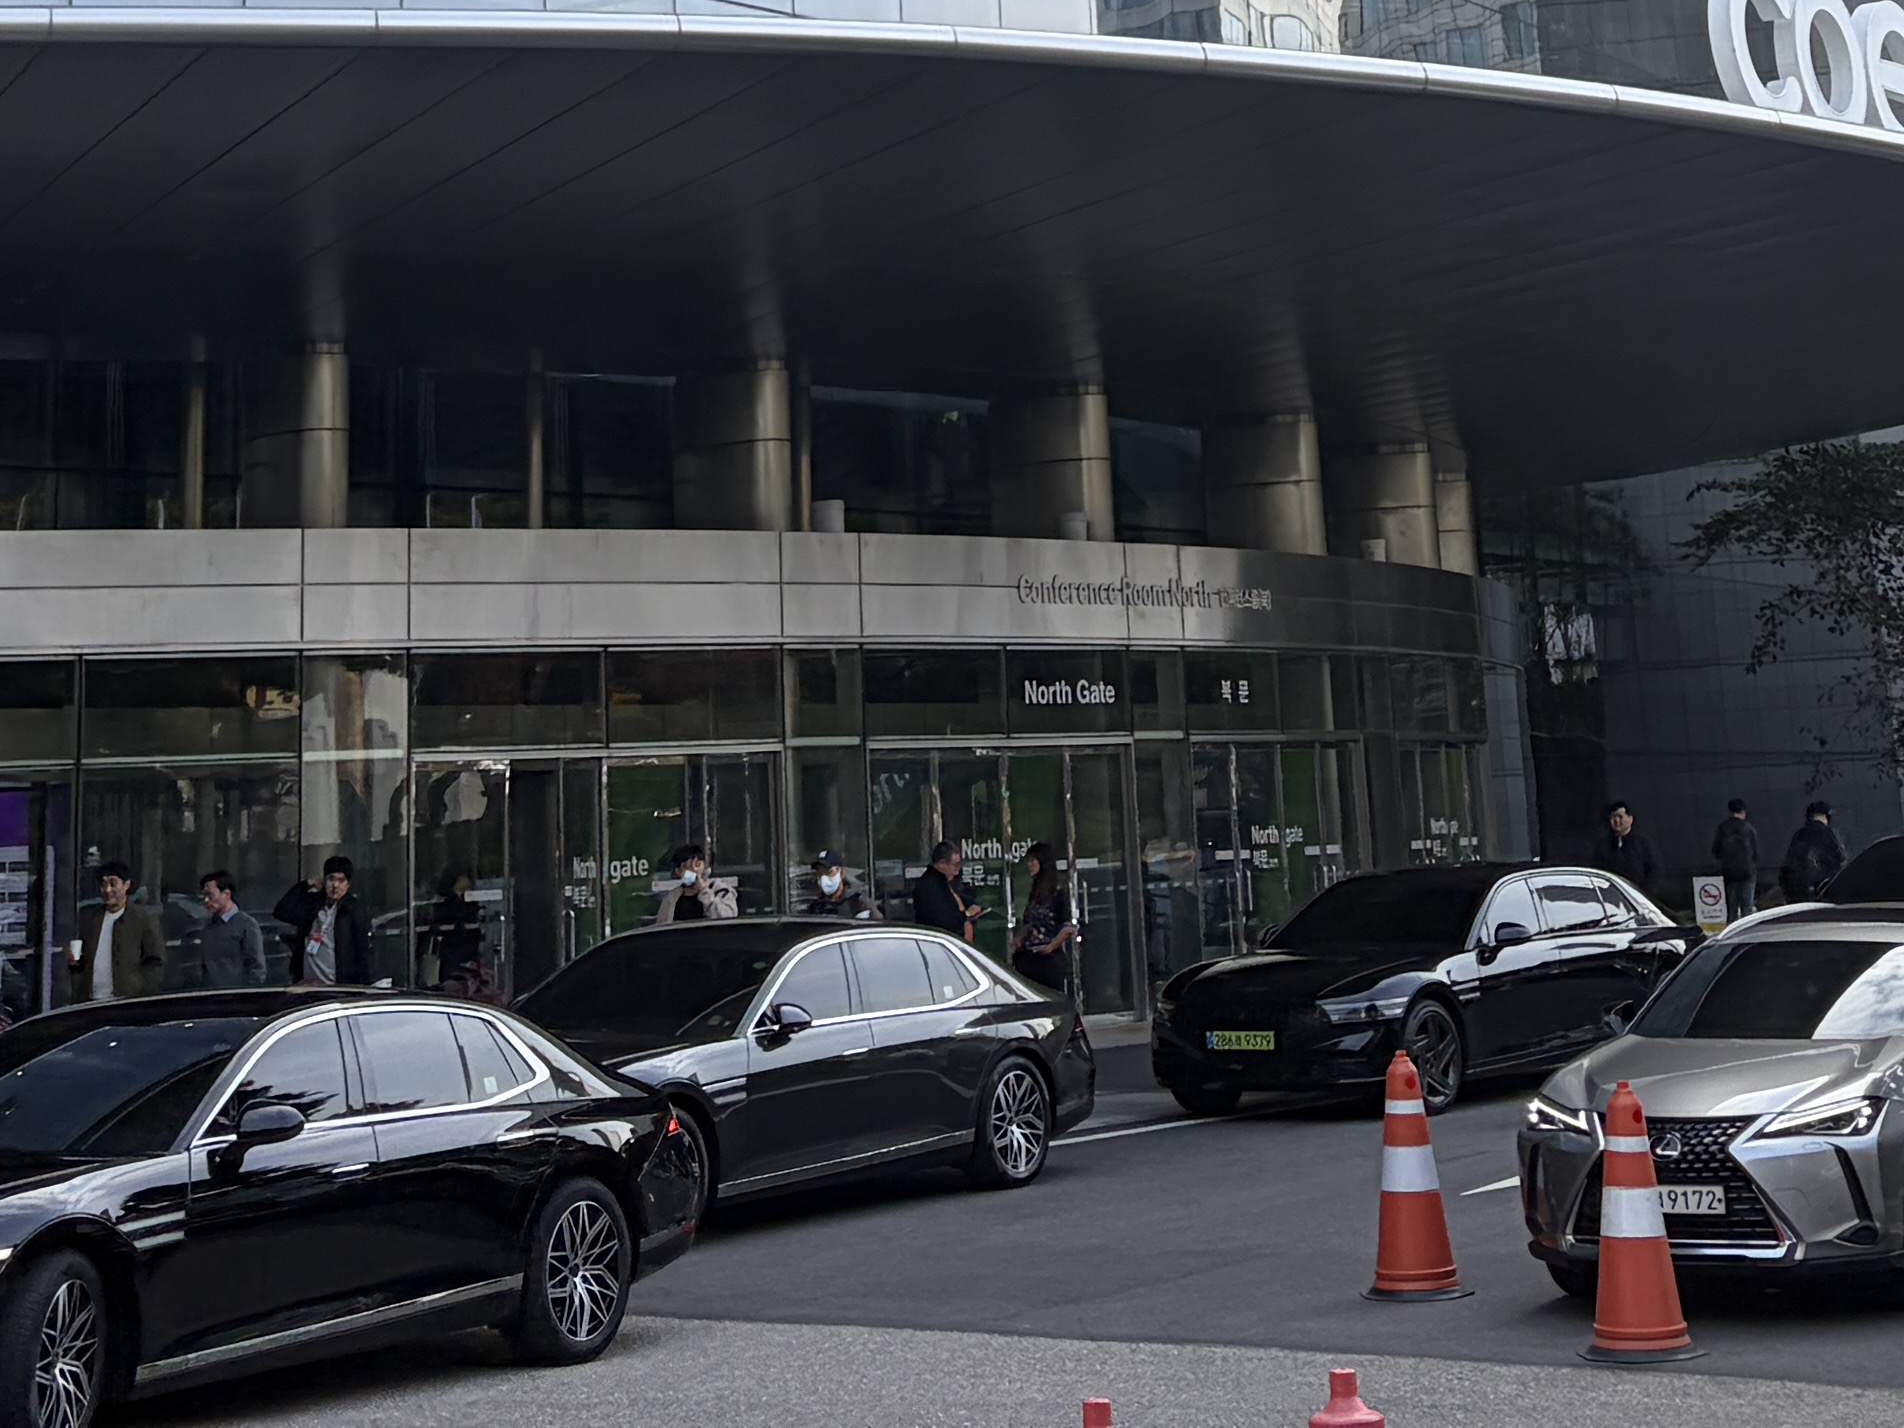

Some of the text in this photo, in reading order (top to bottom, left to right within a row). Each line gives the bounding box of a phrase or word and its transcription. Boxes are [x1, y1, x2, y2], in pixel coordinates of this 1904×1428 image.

[1018, 573, 1117, 605] Conference
[1120, 576, 1166, 606] Room
[1168, 578, 1212, 609] North
[1024, 679, 1116, 705] North Gate
[1251, 825, 1280, 845] North
[961, 837, 1003, 860] North
[609, 855, 650, 885] gate
